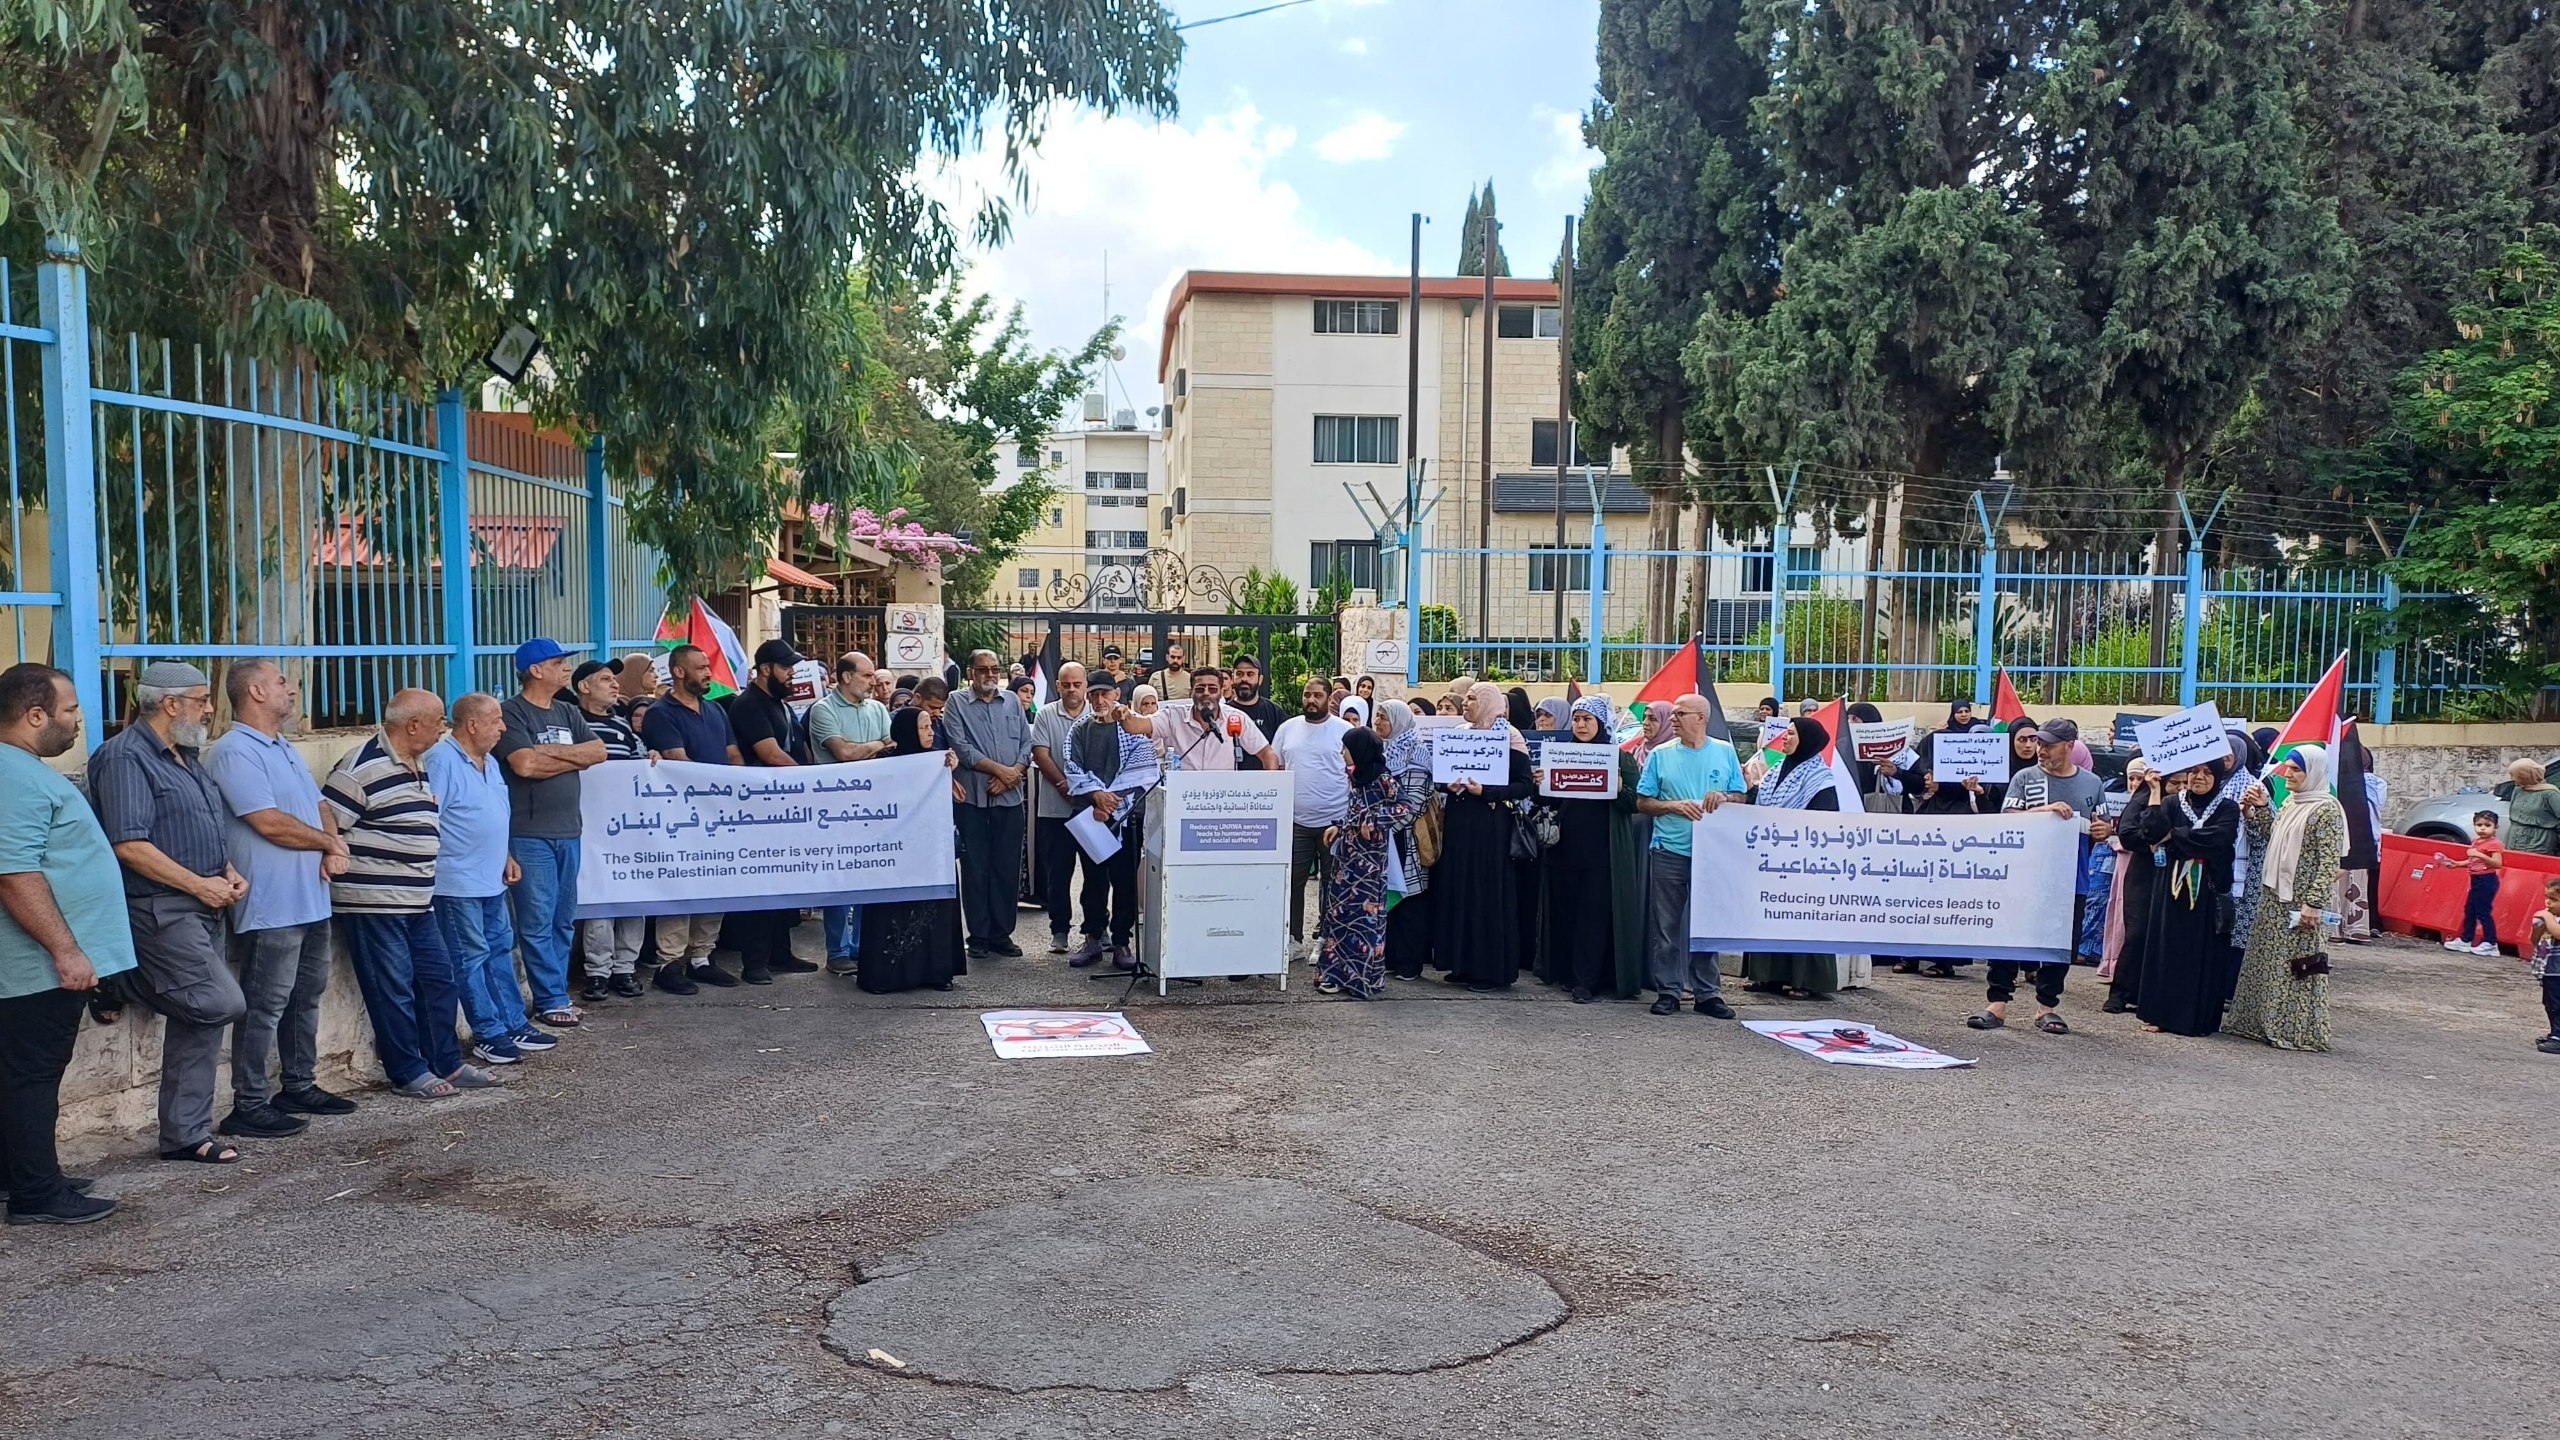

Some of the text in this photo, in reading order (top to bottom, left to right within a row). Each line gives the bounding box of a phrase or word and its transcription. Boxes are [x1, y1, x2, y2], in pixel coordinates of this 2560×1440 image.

[2164, 717, 2191, 732] سبلين
[1465, 734, 1482, 742] مركز
[2203, 735, 2220, 748] مش
[1439, 746, 1470, 757] سبلين
[1451, 763, 1490, 773] للتعليم
[633, 775, 872, 804] معهد سبلين مهم جداً
[1183, 789, 1277, 801] تقليص خدمات الأونروا يؤدي
[1186, 802, 1222, 813] واجتماعية
[1224, 802, 1249, 813] إنسانية
[607, 803, 898, 839] للمجتمع الفلسطيني في لبنان
[1746, 823, 2025, 855] تقليص خدمات الأونروا يؤدي
[603, 841, 903, 864] The Siblin Training Center is very important
[613, 858, 896, 880] to the Palestinian community in Lebanon
[1759, 854, 2009, 883] لمعاناة إنسانية واجتماعية
[1761, 892, 2000, 910] Reducing UNRWA services leads to
[1764, 908, 1993, 928] humanitarian and social suffering
